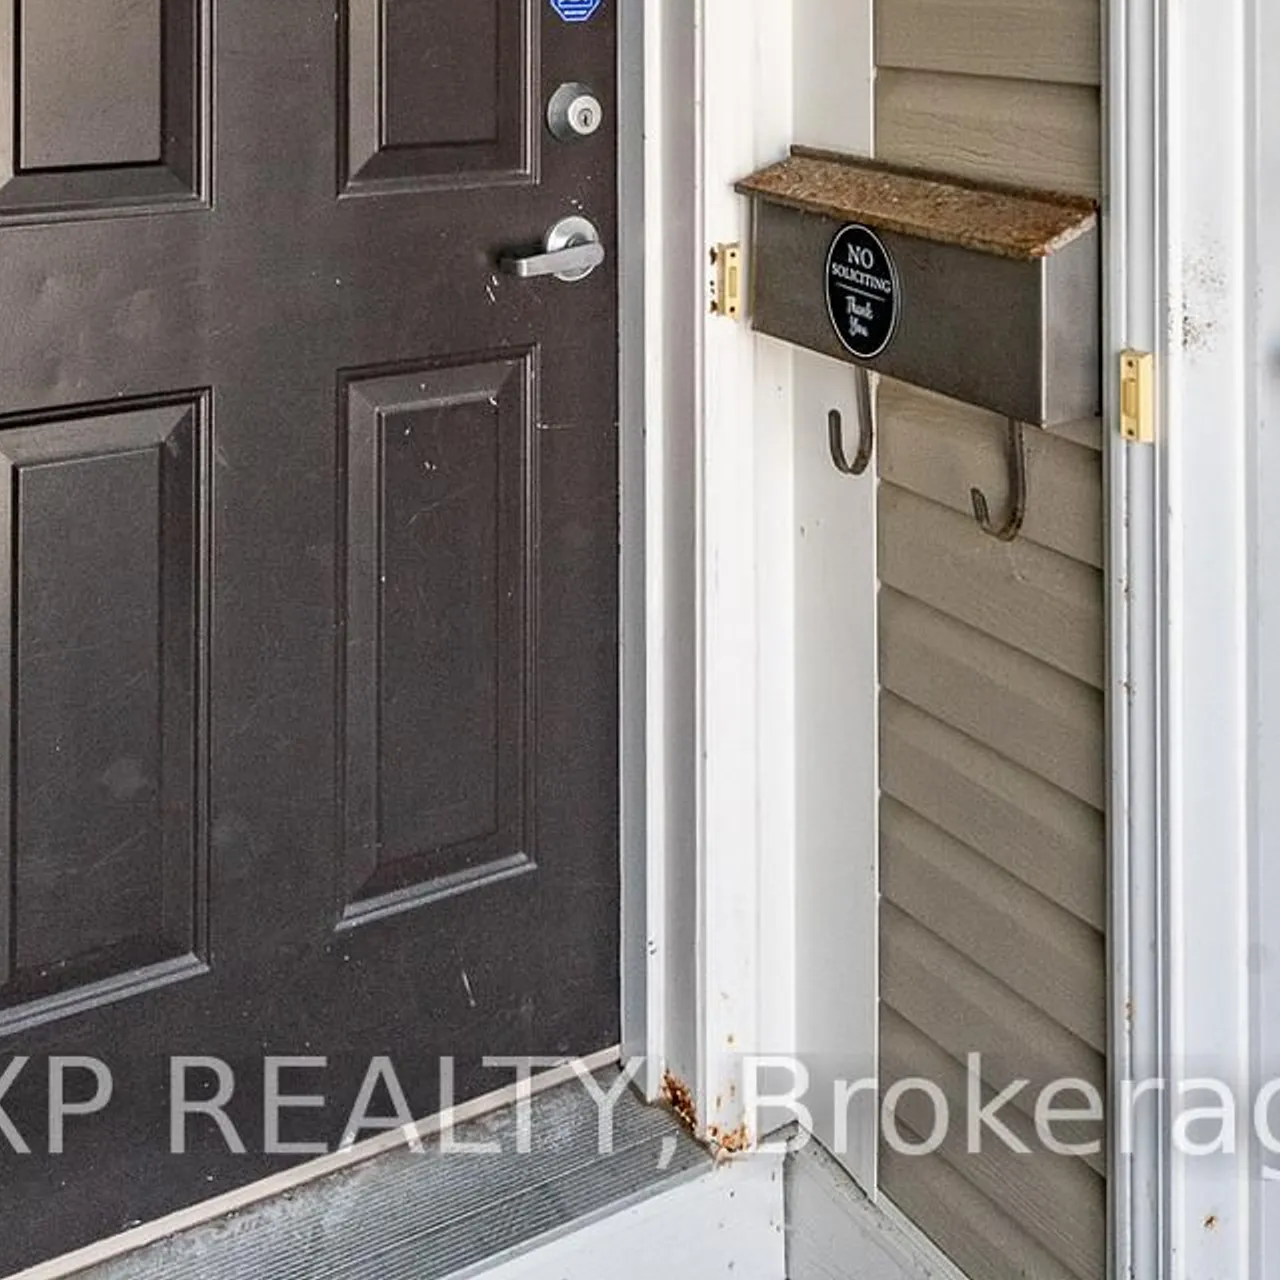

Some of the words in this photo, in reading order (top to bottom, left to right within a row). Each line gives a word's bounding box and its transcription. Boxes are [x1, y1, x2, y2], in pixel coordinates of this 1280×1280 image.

[847, 243, 874, 269] NO
[831, 263, 892, 294] SOLICITING
[845, 296, 874, 320] Thank
